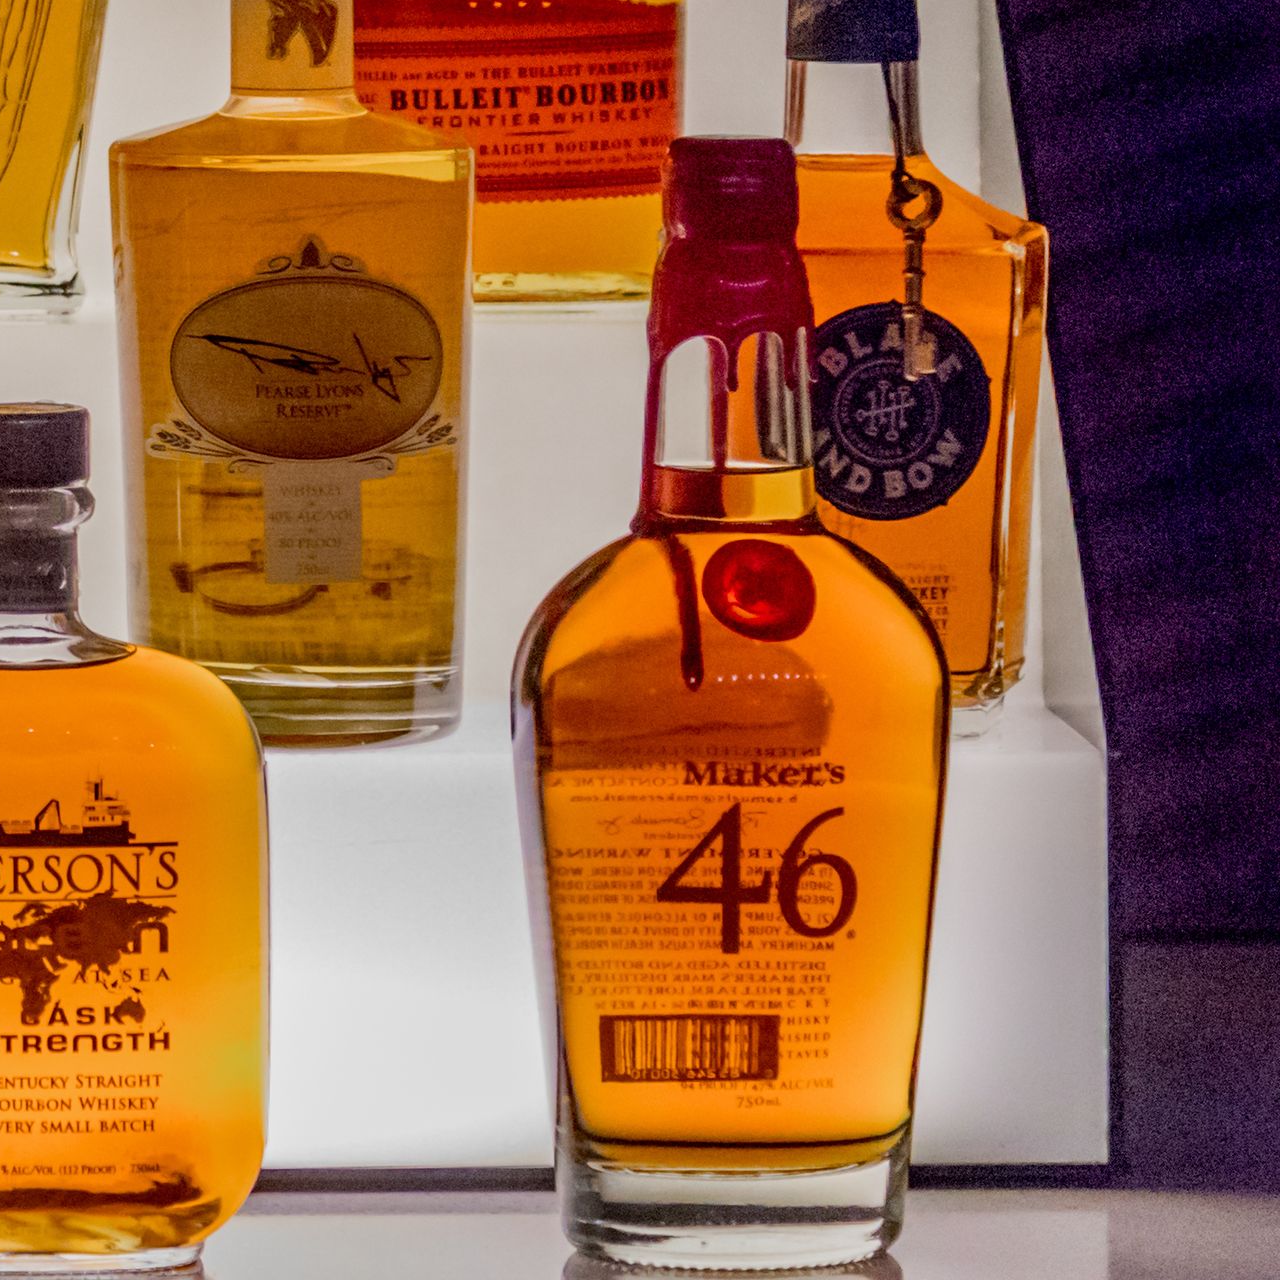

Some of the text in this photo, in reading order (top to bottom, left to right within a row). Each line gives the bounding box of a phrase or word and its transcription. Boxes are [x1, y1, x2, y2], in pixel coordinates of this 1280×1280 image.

[481, 67, 511, 80] THE
[390, 86, 521, 111] BULLEIT
[536, 79, 669, 107] BOURBON
[418, 107, 653, 128] FRONTIER WHISKEY
[479, 142, 546, 157] RAIGHT
[819, 323, 963, 383] BLAE
[256, 382, 365, 399] PEARSE LYONS
[682, 760, 846, 788] Maker's
[657, 801, 858, 955] 46
[121, 967, 171, 983] SEA
[75, 1073, 162, 1089] STRAIGHT
[79, 1095, 160, 1110] WHISKEY
[40, 1120, 93, 1134] SMALL
[99, 1119, 156, 1133] BATCH
